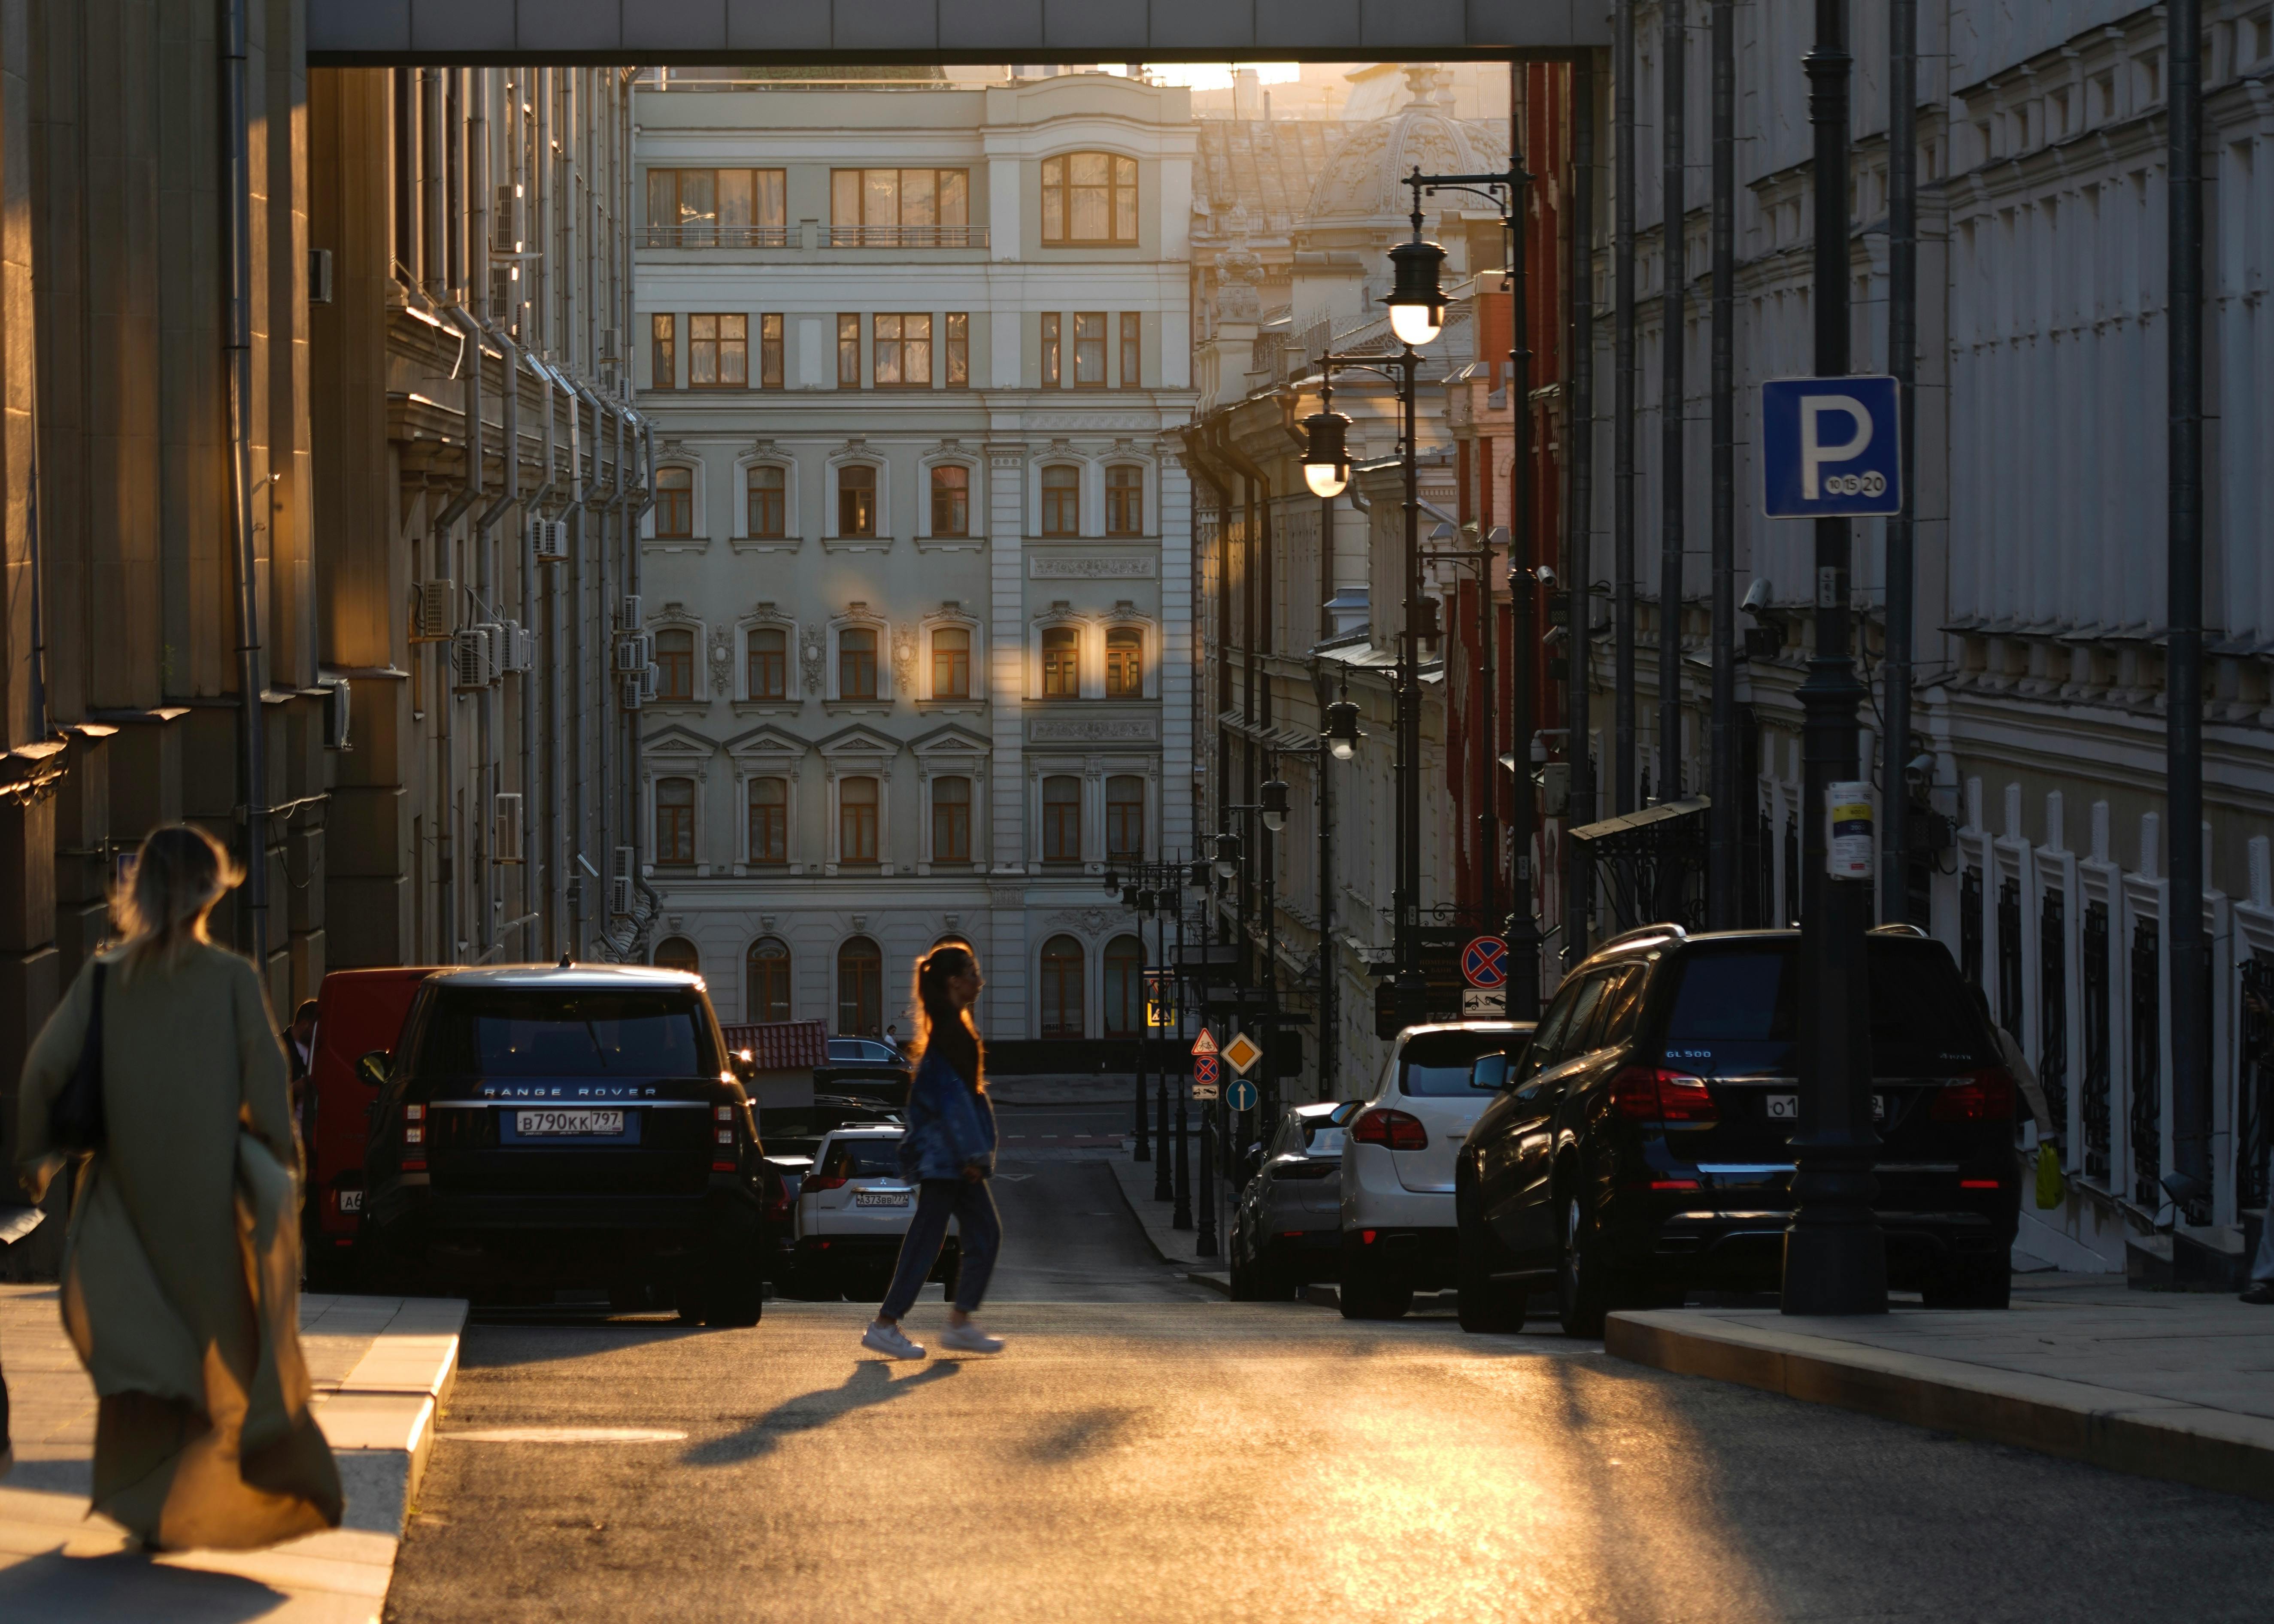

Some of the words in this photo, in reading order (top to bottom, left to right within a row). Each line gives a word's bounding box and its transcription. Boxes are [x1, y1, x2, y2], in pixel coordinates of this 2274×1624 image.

[1800, 395, 1874, 500] P
[1829, 480, 1840, 489] 10
[1844, 478, 1857, 490] 15
[1863, 477, 1883, 492] 20
